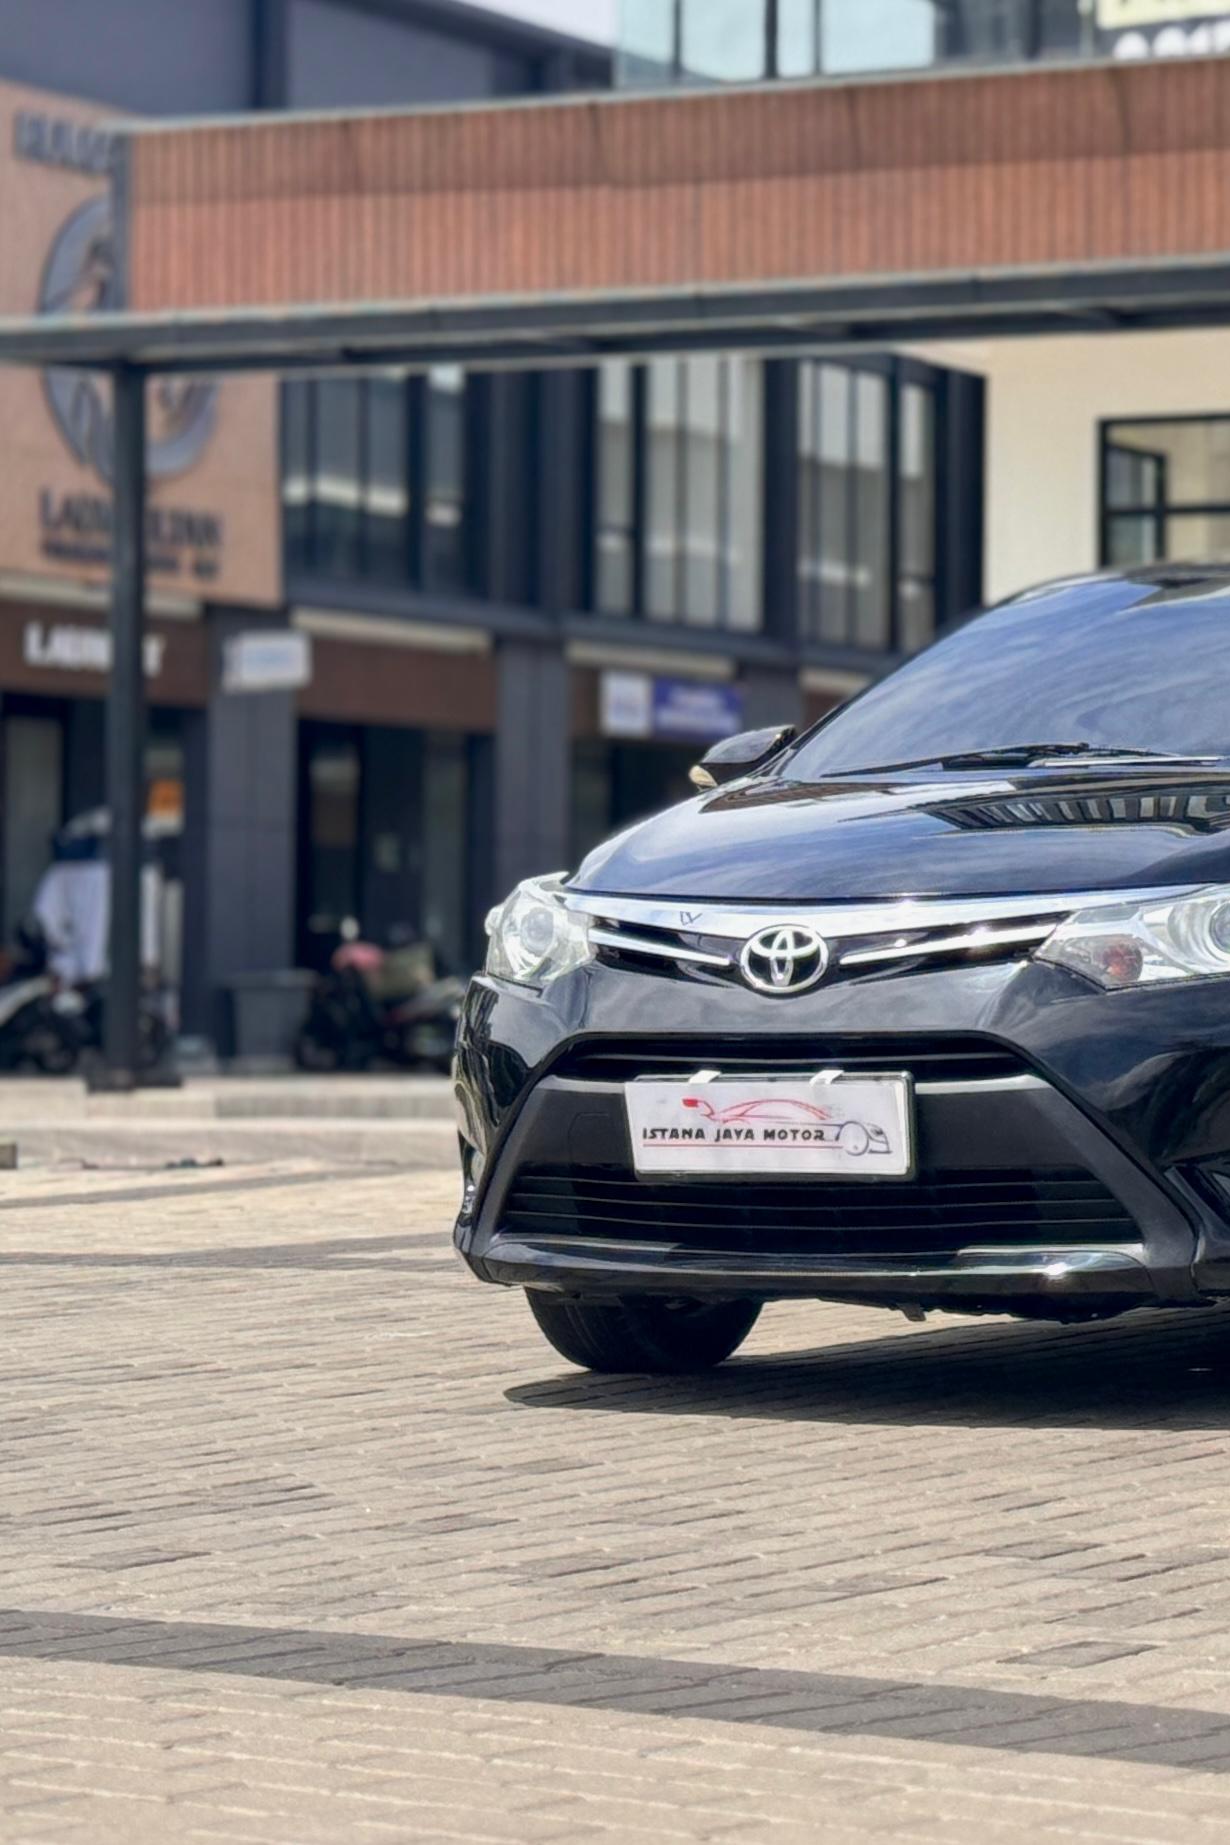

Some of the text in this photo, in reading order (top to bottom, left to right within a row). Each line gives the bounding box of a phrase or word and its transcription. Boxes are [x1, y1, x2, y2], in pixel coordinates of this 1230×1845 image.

[643, 1128, 825, 1142] ISTANA JAYA MOTOR
